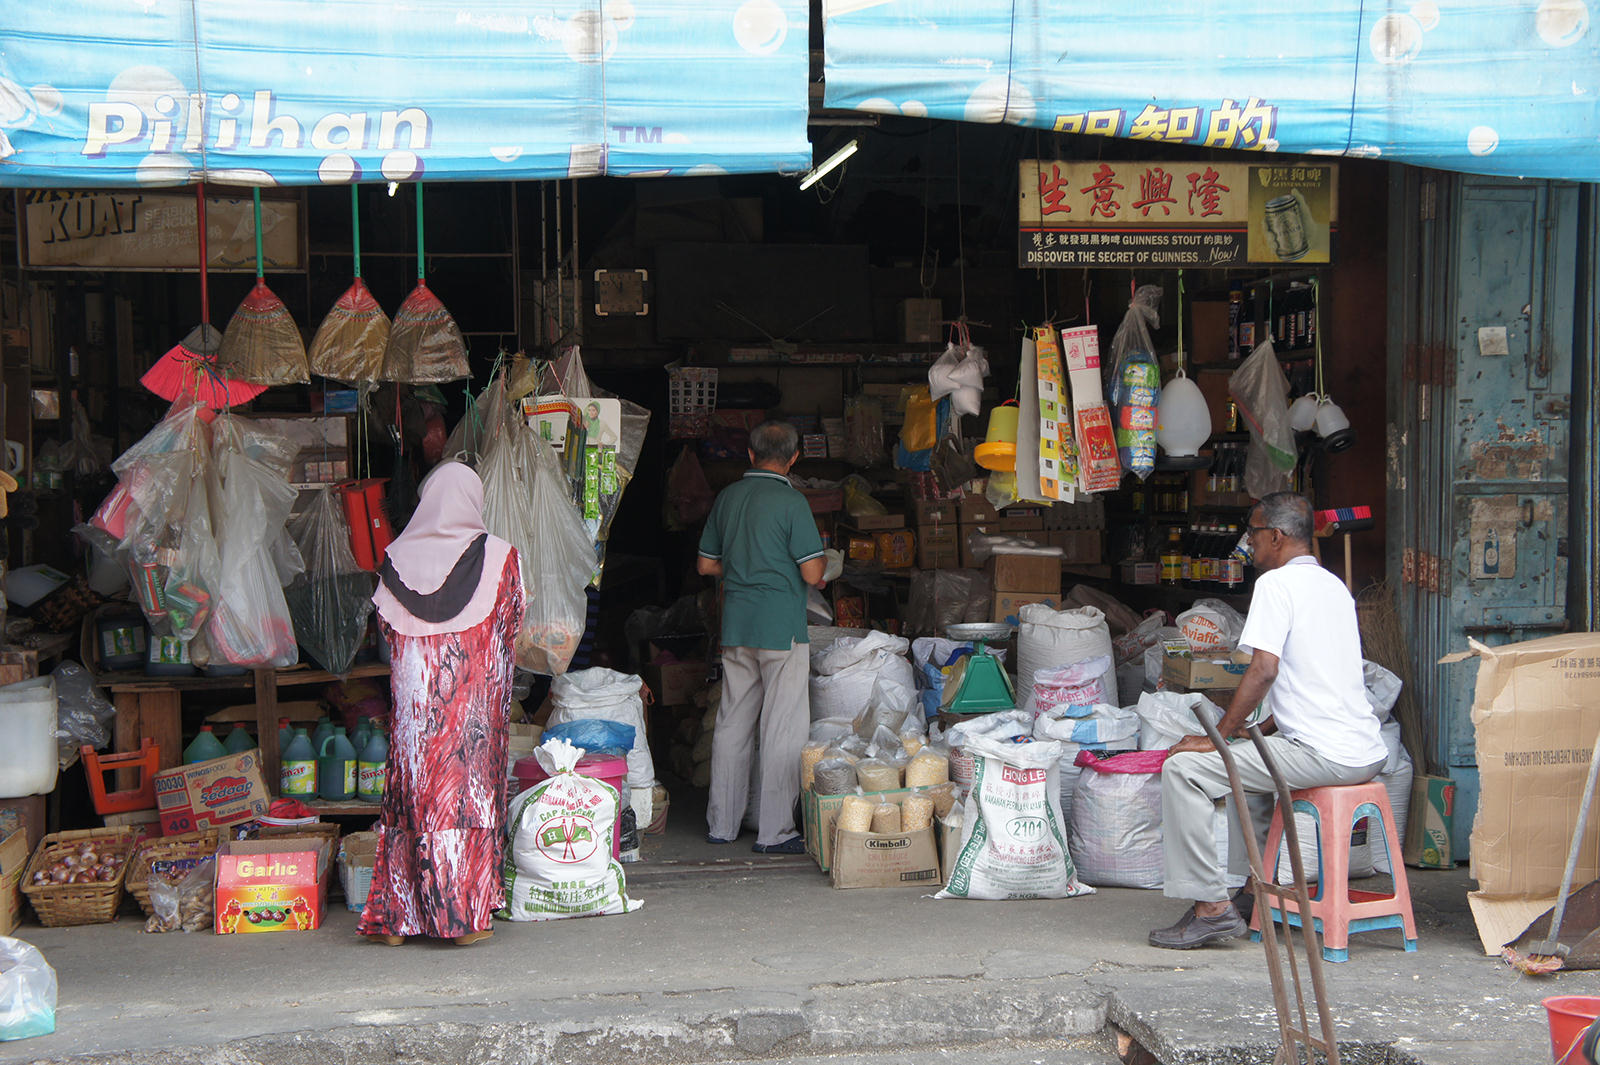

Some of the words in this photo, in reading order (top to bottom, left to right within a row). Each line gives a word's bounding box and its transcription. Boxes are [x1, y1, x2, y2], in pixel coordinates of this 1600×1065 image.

[81, 90, 432, 159] Pilihan
[612, 125, 663, 144] TM
[1037, 163, 1230, 218] 生意興隆
[1122, 235, 1169, 246] GUINNESS
[1171, 235, 1201, 246] STOUT
[1027, 251, 1075, 263] DISCOVER
[1077, 251, 1096, 263] THE
[1098, 252, 1135, 263] SECRET
[1136, 252, 1150, 263] OF
[1003, 769, 1028, 783] HONG
[156, 775, 184, 793] 20030
[199, 781, 253, 804] Sedaap
[539, 809, 558, 822] CAP
[168, 818, 190, 832] 40
[1013, 820, 1043, 837] 2101
[547, 831, 558, 841] H
[869, 839, 908, 849] Kimball
[237, 860, 298, 878] Garlic
